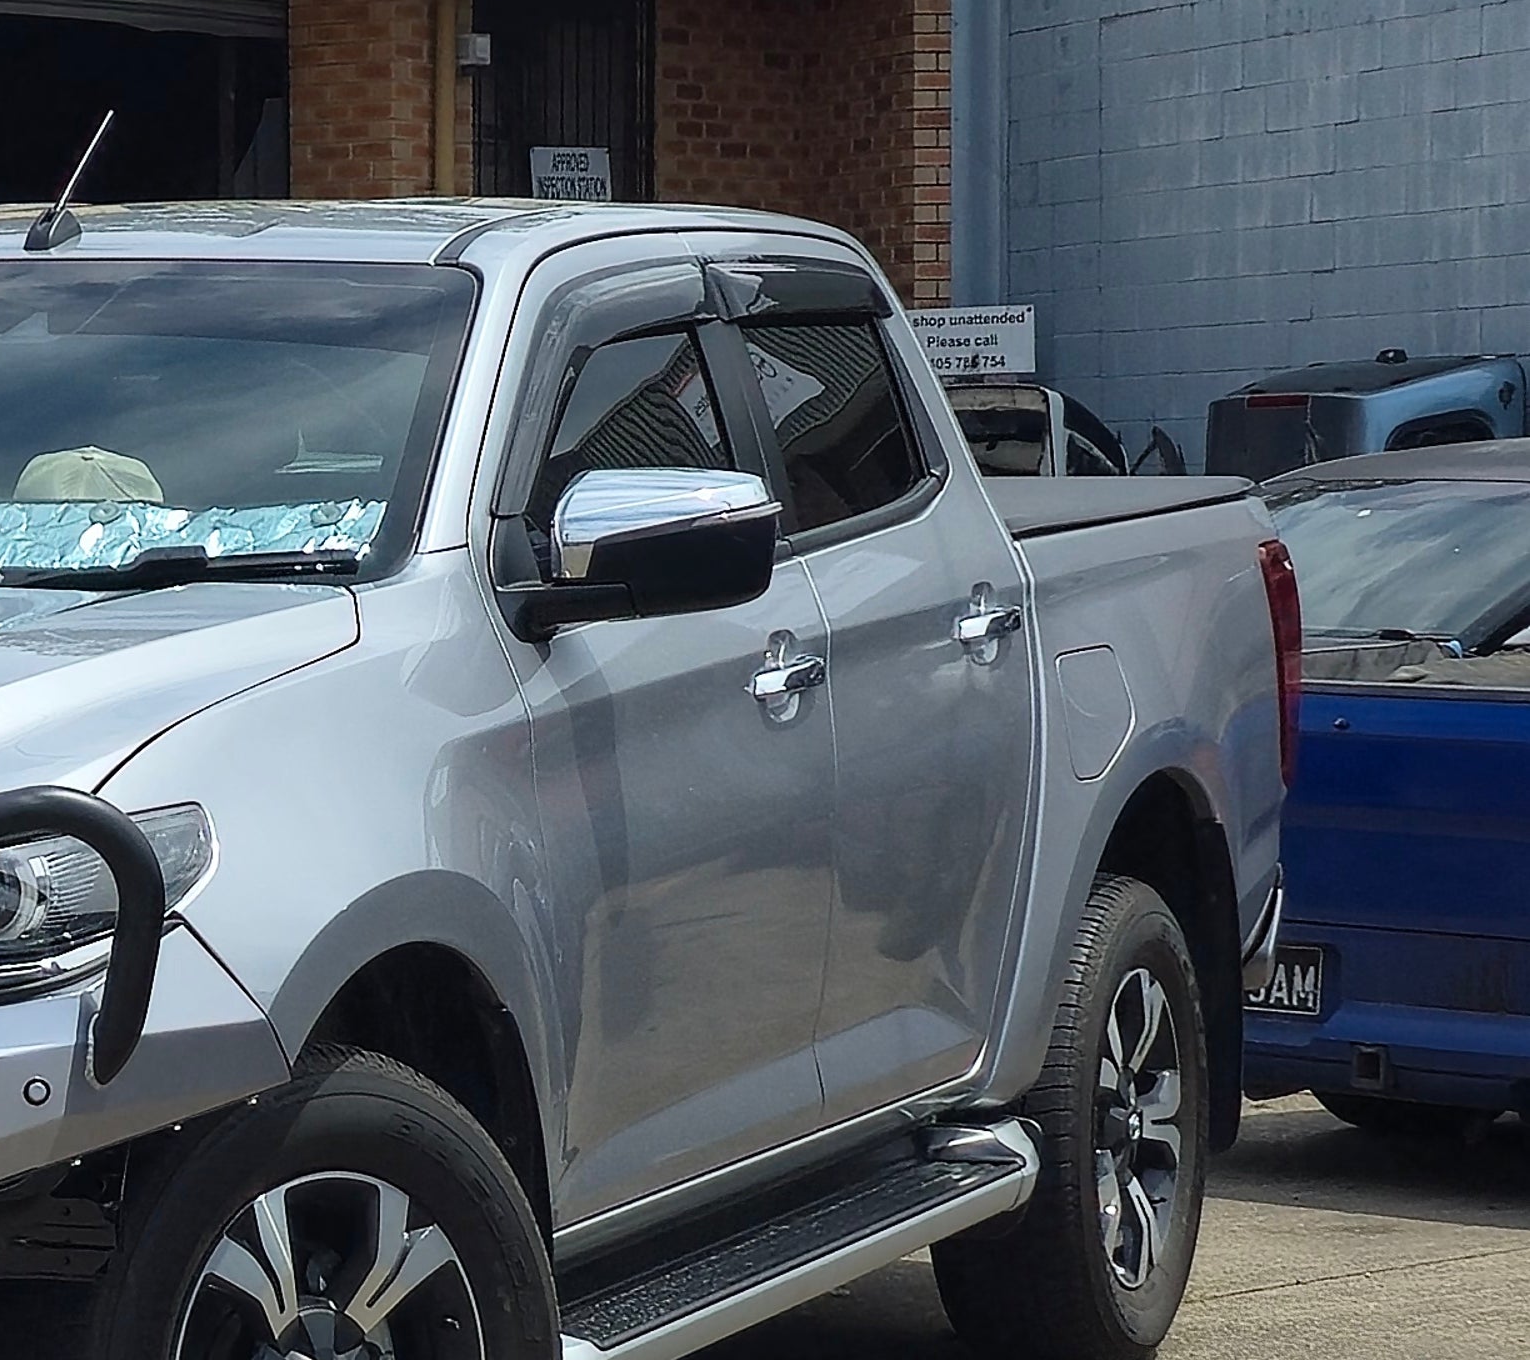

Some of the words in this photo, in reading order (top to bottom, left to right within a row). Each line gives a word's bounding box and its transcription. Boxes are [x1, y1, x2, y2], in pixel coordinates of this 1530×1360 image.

[913, 315, 946, 328] shop
[949, 311, 1026, 326] unattended
[927, 335, 971, 348] Please
[974, 333, 999, 347] call
[981, 355, 1006, 368] 754
